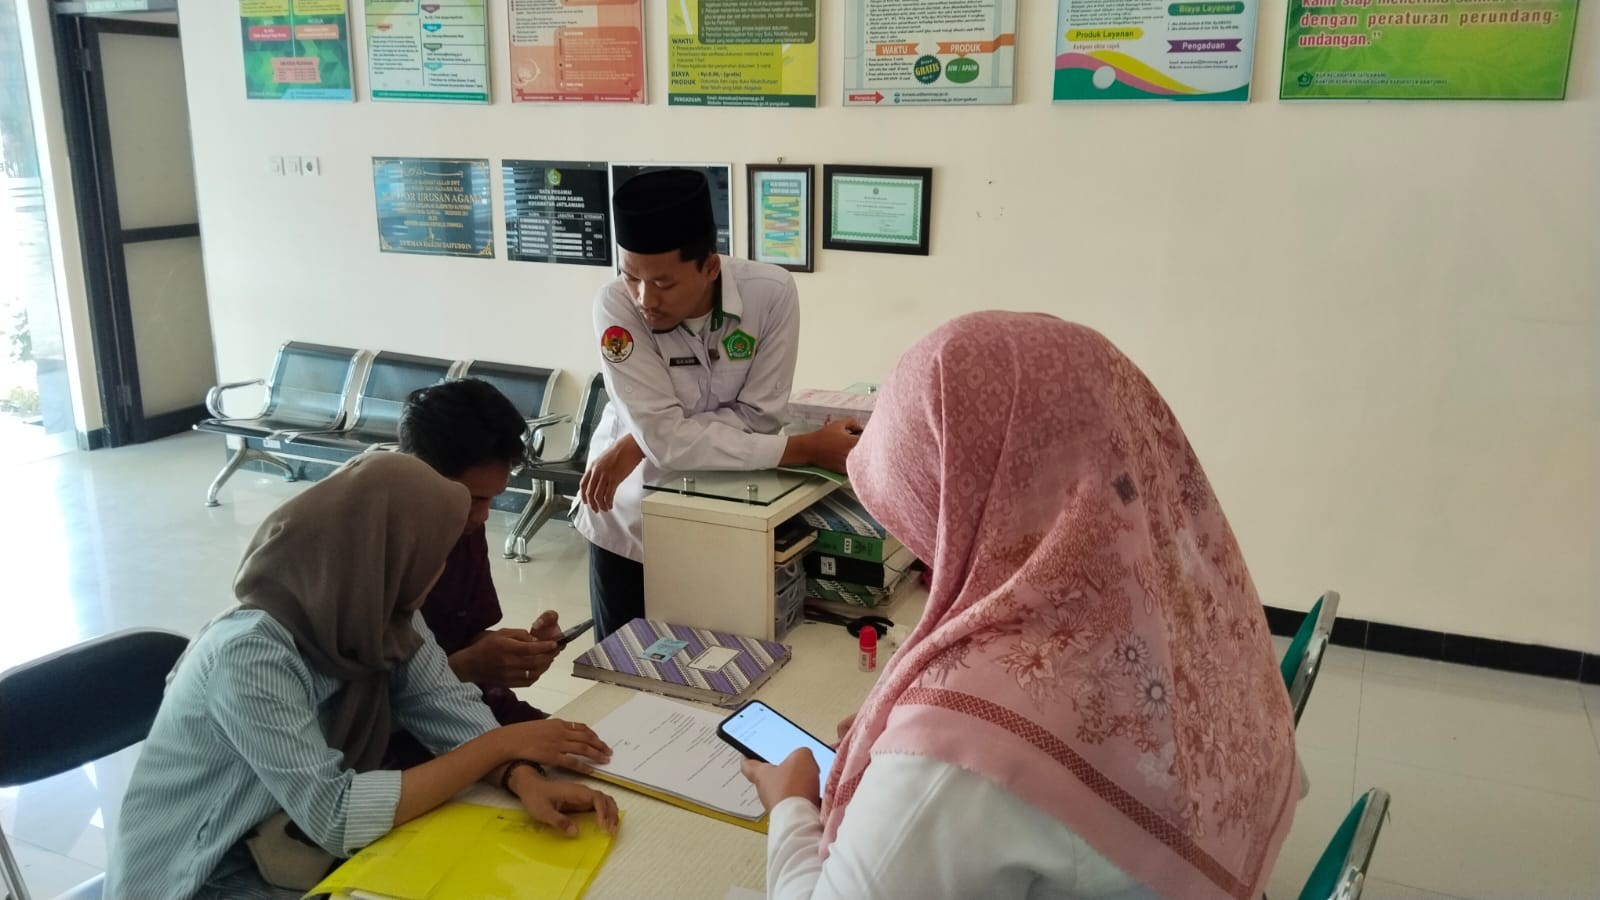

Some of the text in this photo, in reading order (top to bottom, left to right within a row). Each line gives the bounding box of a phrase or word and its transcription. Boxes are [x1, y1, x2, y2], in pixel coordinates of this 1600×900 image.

[1301, 9, 1559, 27] dengan peraturan perundang-
[1076, 30, 1134, 39] Produk Layanan
[881, 45, 909, 54] WAKTU
[950, 43, 982, 53] PRODUK
[1182, 42, 1226, 51] Pengaduan
[915, 64, 940, 76] GRATIS
[417, 191, 450, 202] URUSAN
